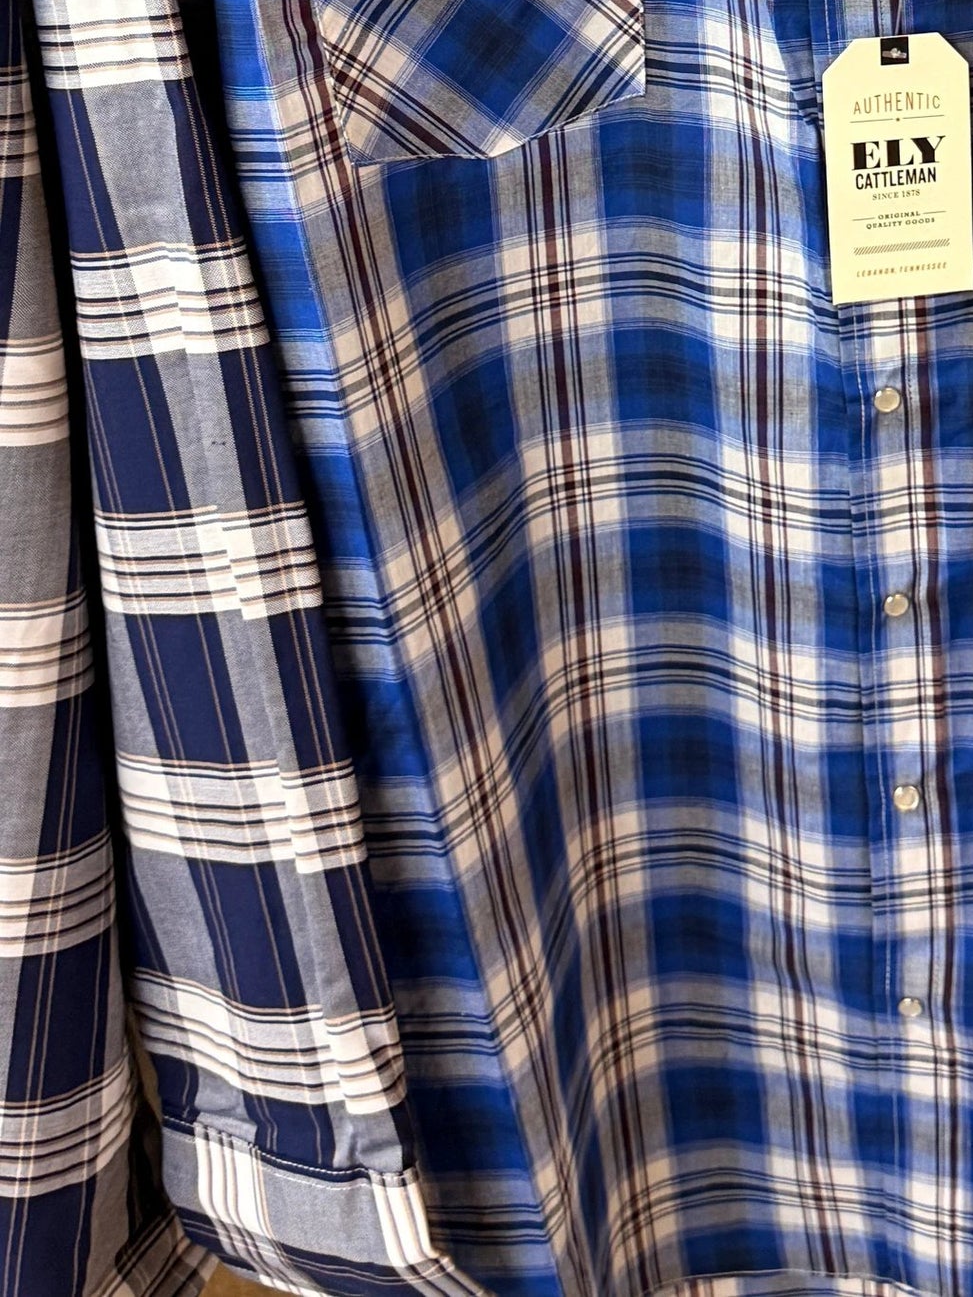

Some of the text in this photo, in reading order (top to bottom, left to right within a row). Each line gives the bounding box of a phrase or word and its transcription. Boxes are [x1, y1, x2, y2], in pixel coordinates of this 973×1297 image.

[853, 91, 941, 115] AUTHENTIC
[850, 135, 946, 171] ELY
[855, 166, 937, 190] CATTLEMAN
[872, 188, 921, 201] SINCE 1878
[877, 210, 921, 220] ORIGINAL
[866, 217, 936, 230] QUALITY GOODS
[899, 261, 948, 273] TENNESSEE
